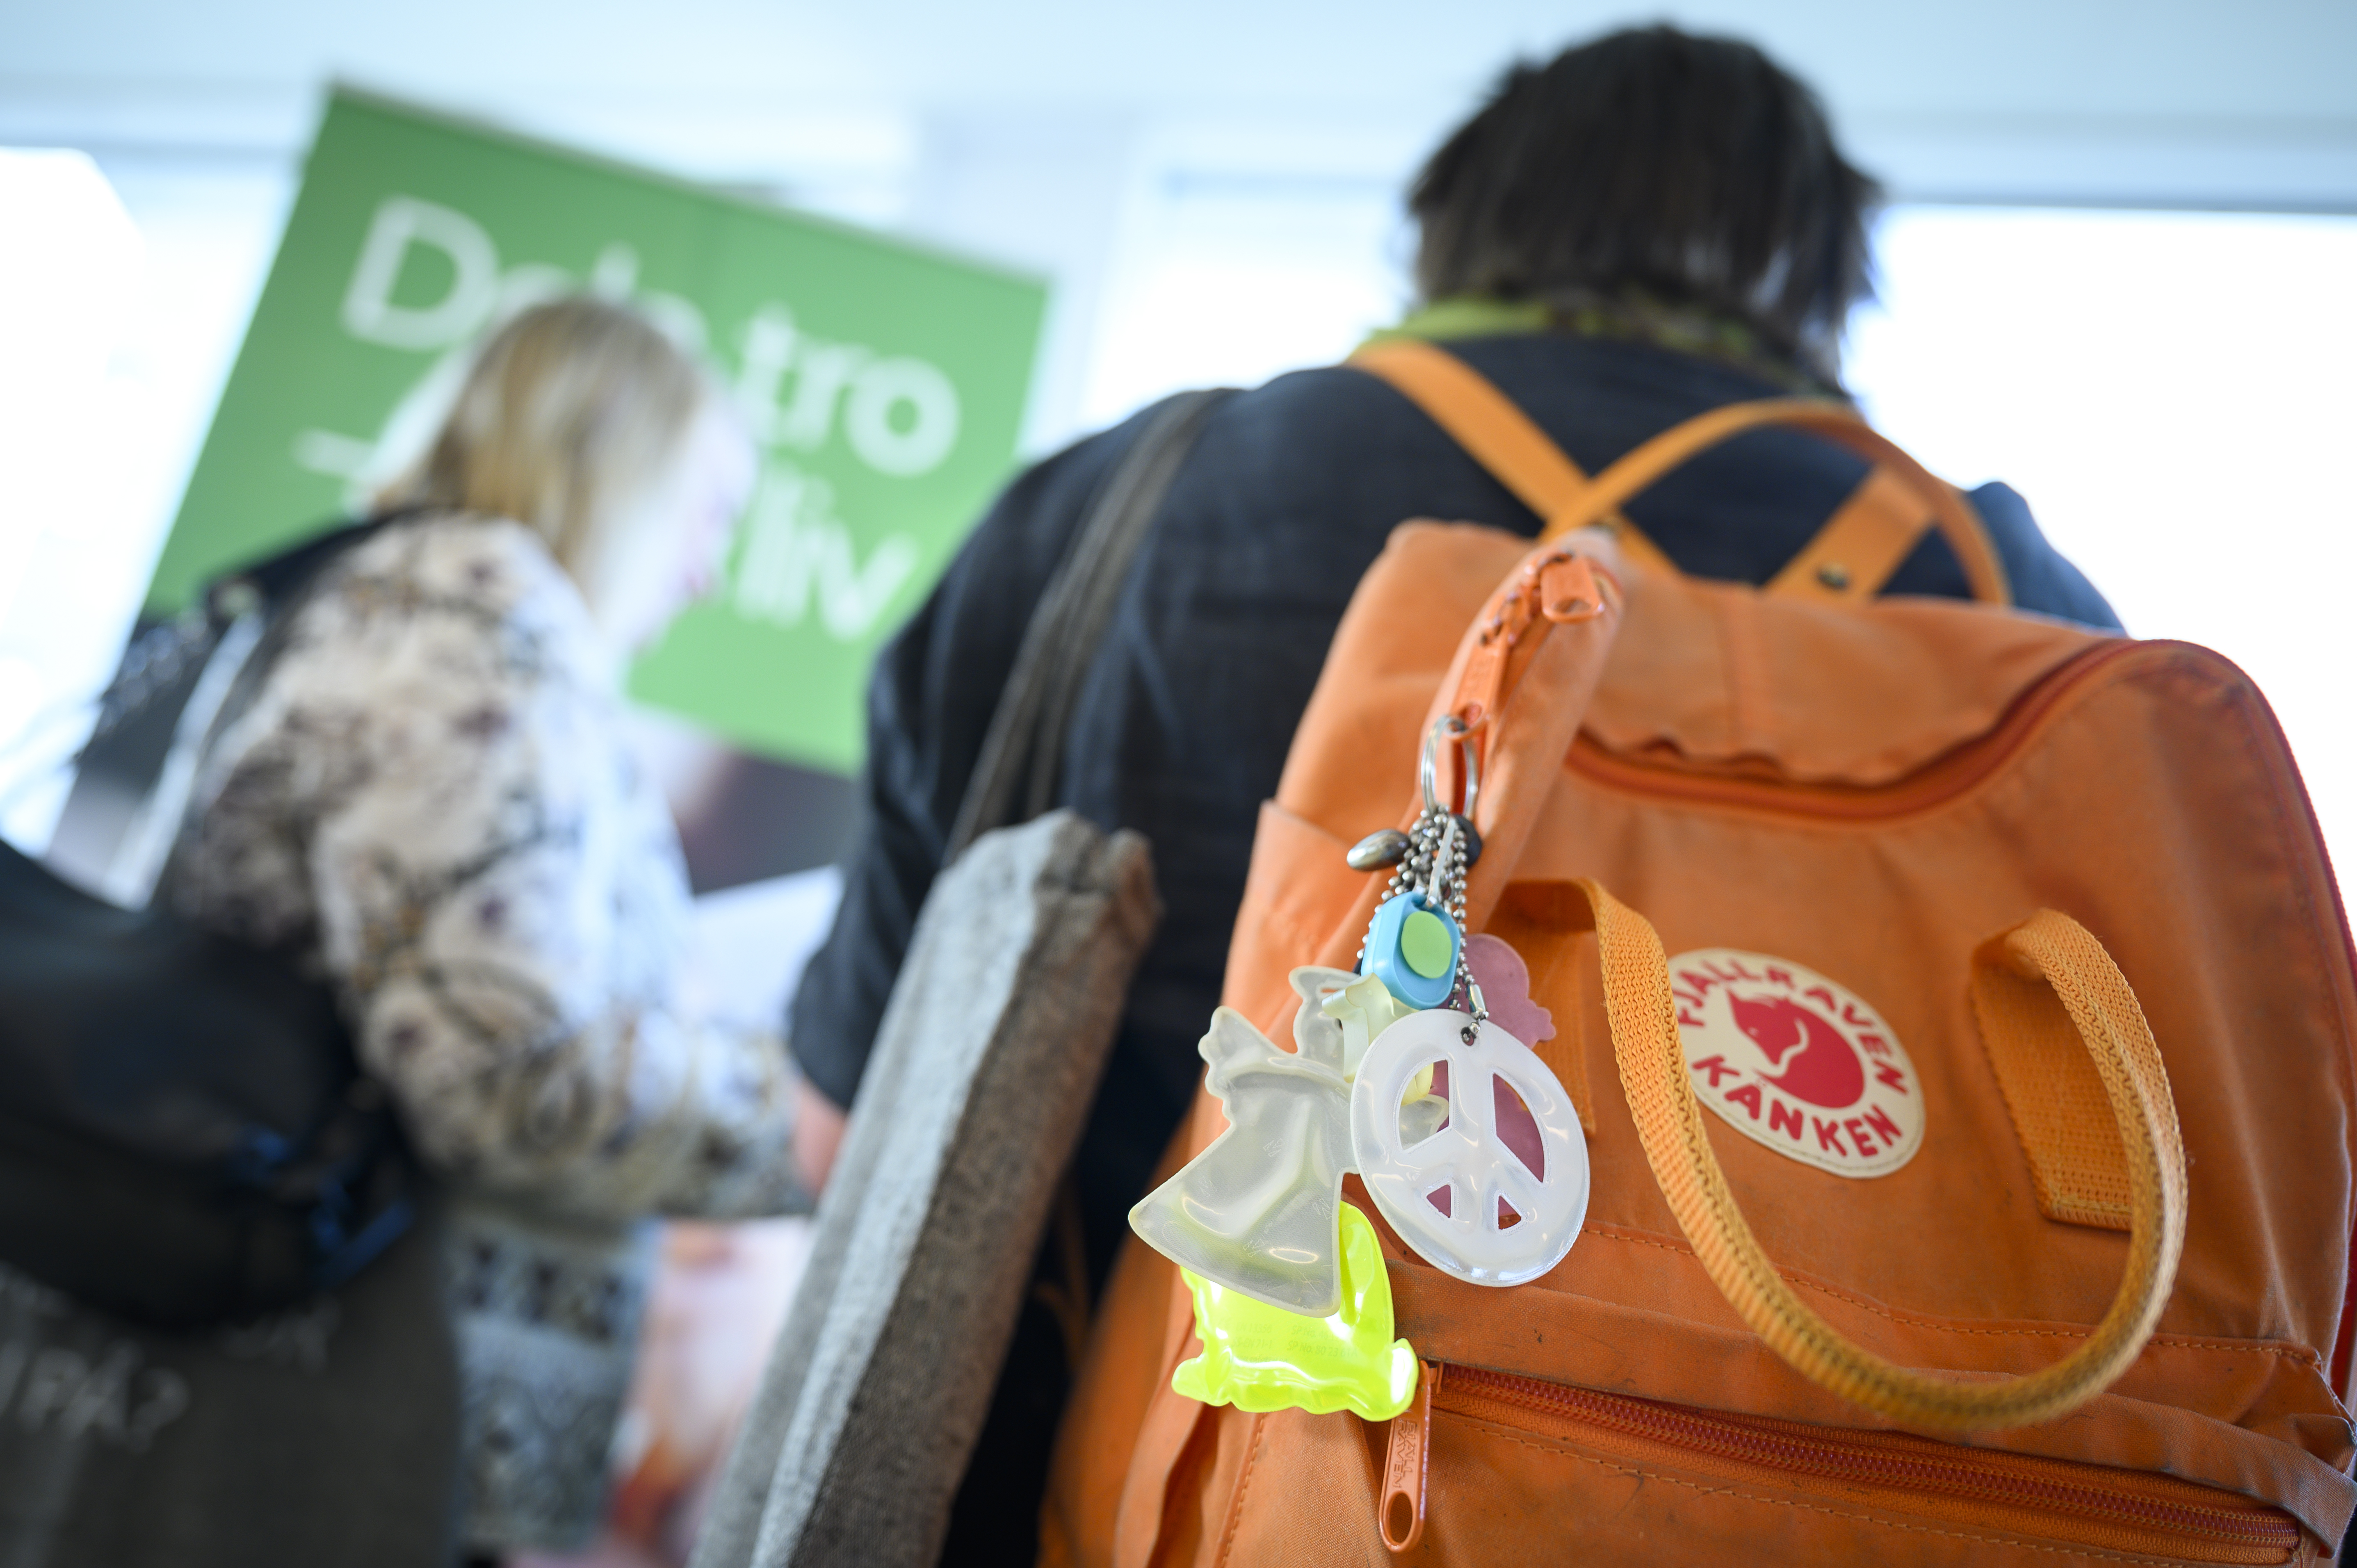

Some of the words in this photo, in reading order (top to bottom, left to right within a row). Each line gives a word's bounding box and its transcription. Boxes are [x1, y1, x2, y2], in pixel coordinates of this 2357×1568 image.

[734, 301, 960, 478] tro
[1291, 1325, 1302, 1335] SP
[1303, 1326, 1316, 1338] No.
[1287, 1340, 1298, 1351] SP
[1299, 1342, 1313, 1353] No.
[1315, 1345, 1326, 1355] 80
[1328, 1347, 1338, 1357] 23
